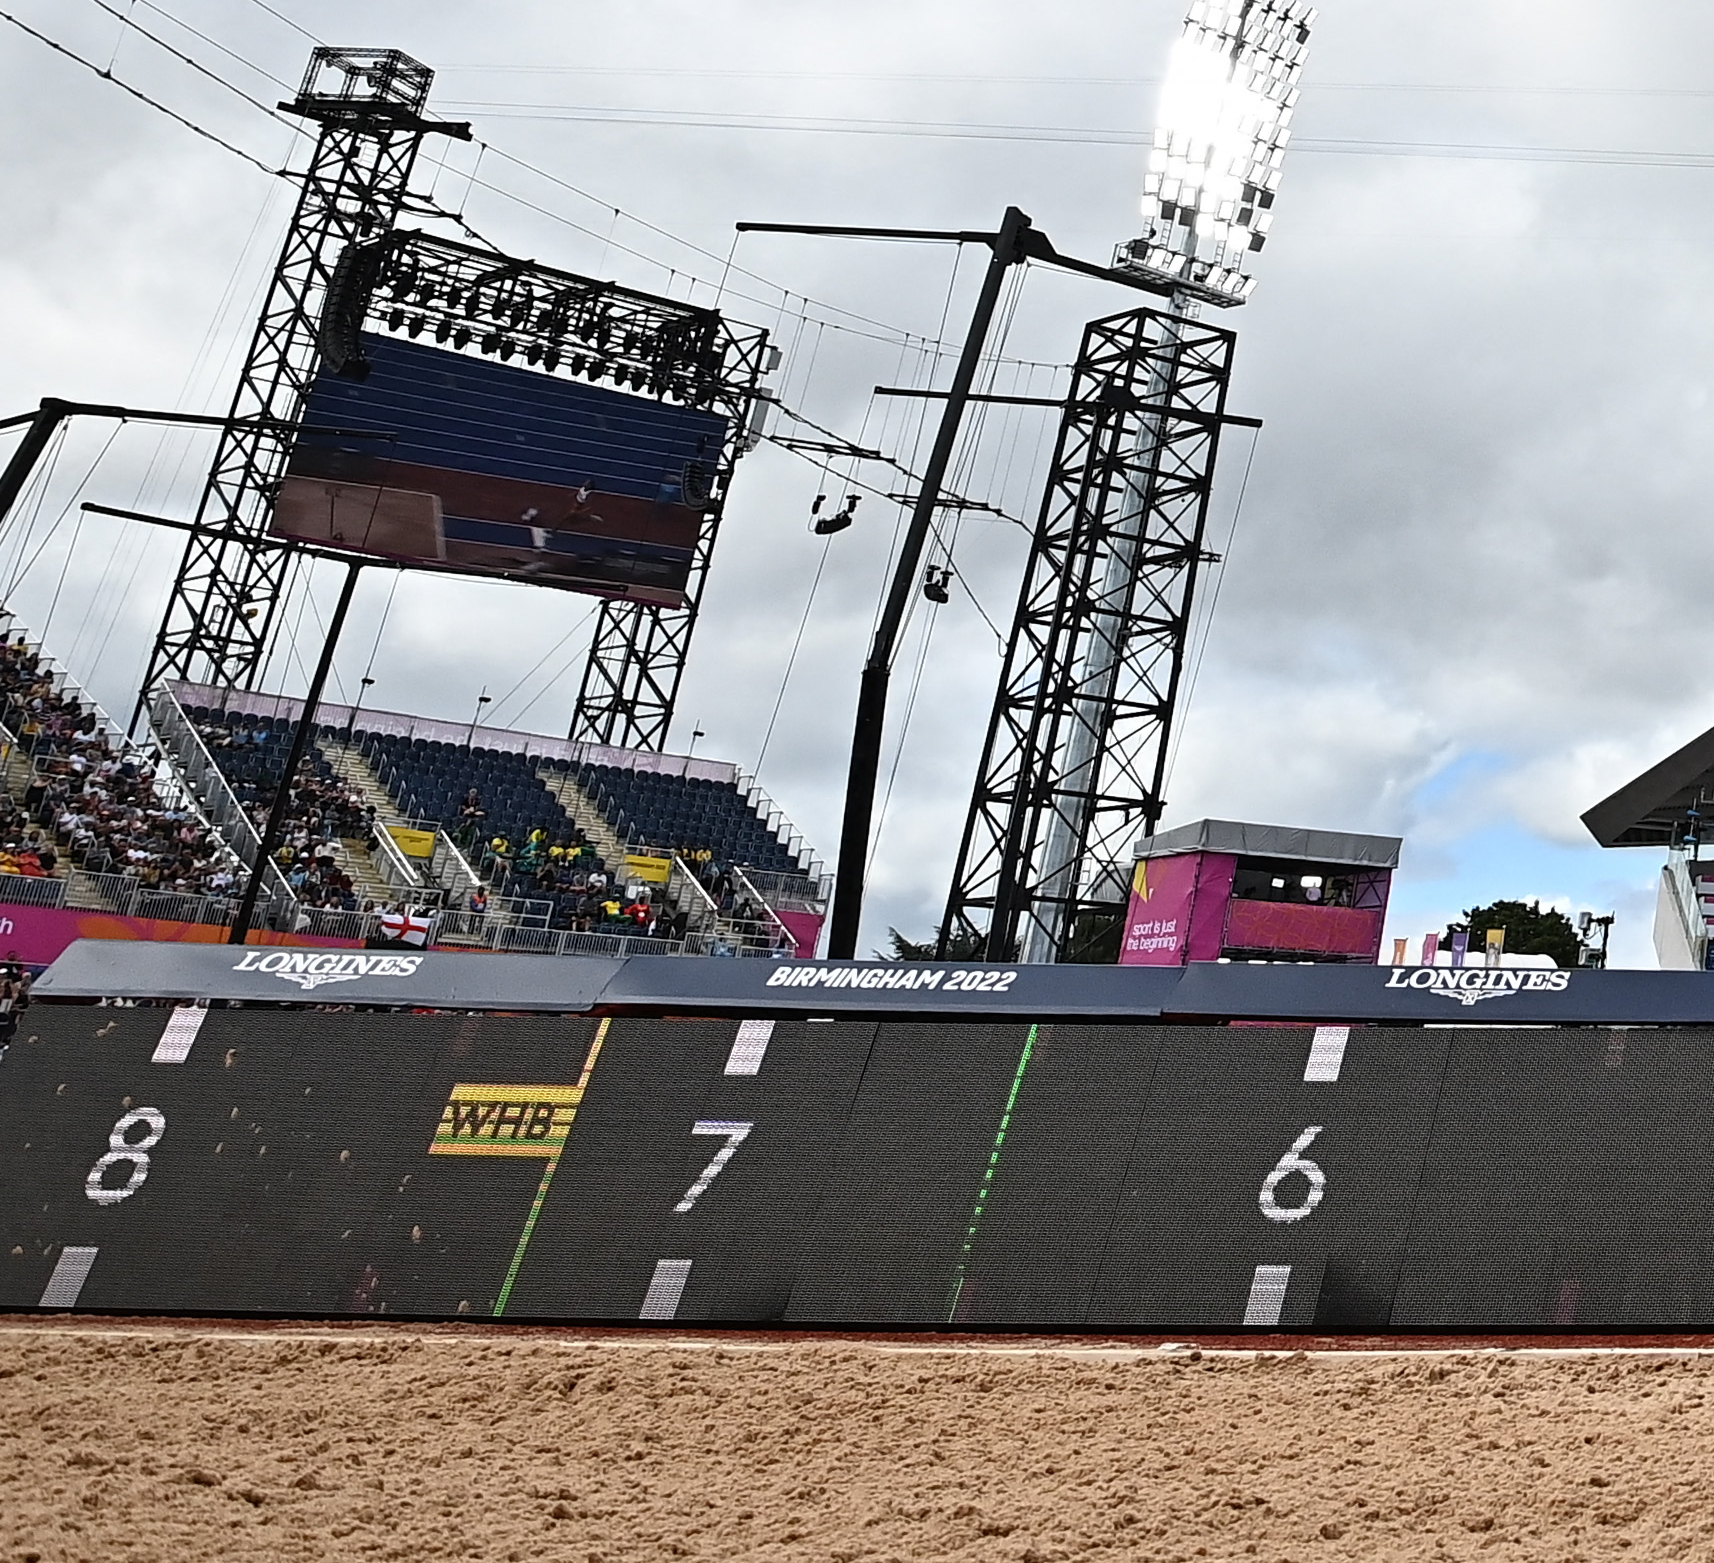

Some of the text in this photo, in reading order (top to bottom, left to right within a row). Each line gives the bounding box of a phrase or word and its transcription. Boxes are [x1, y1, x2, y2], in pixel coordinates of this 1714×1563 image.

[1139, 935, 1177, 953] beginning
[232, 951, 424, 977] LONGINES
[766, 966, 1018, 992] BIRMINGHAM 2022
[1385, 968, 1571, 991] LONGINES
[85, 1107, 167, 1206] 8
[675, 1121, 754, 1213] 7
[1259, 1126, 1326, 1223] 6
